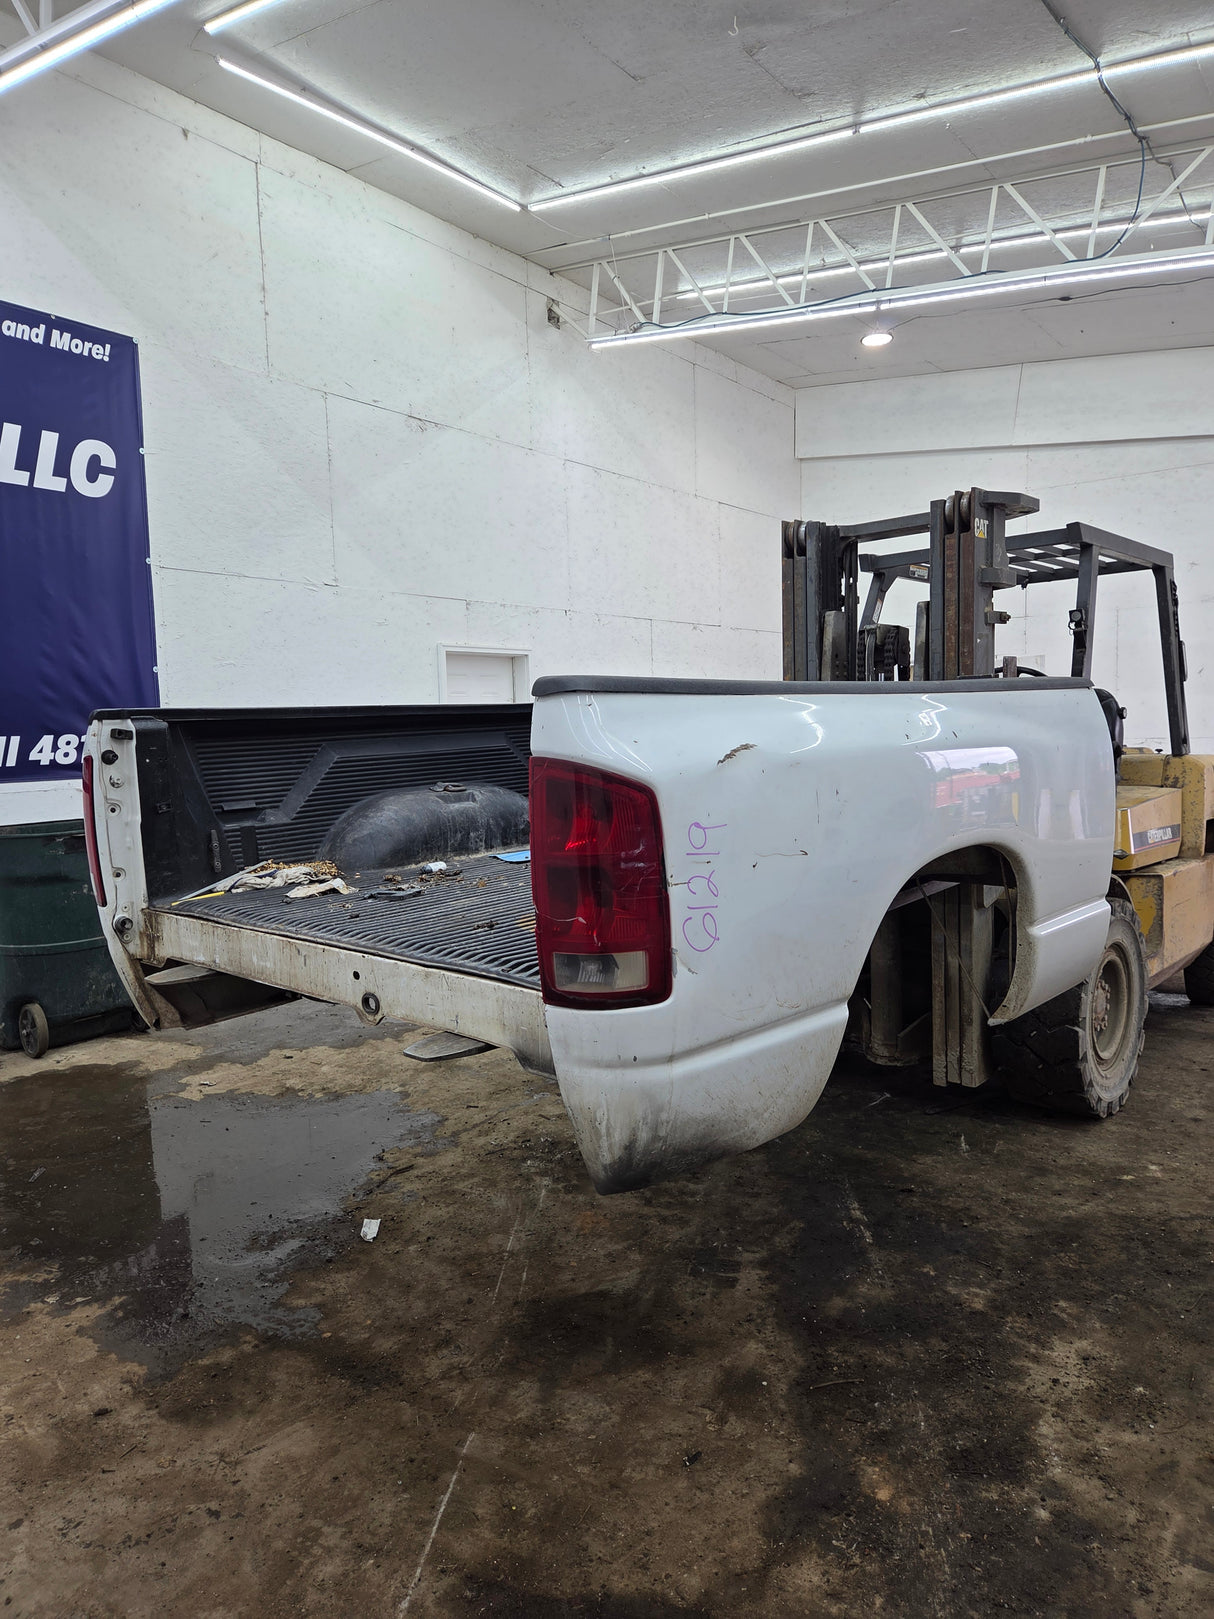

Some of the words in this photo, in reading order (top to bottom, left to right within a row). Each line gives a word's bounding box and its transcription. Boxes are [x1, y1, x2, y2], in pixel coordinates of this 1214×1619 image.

[1, 319, 46, 345] and
[50, 329, 111, 362] More!
[0, 422, 117, 498] LLC
[975, 517, 989, 539] CAT
[29, 734, 87, 766] 48
